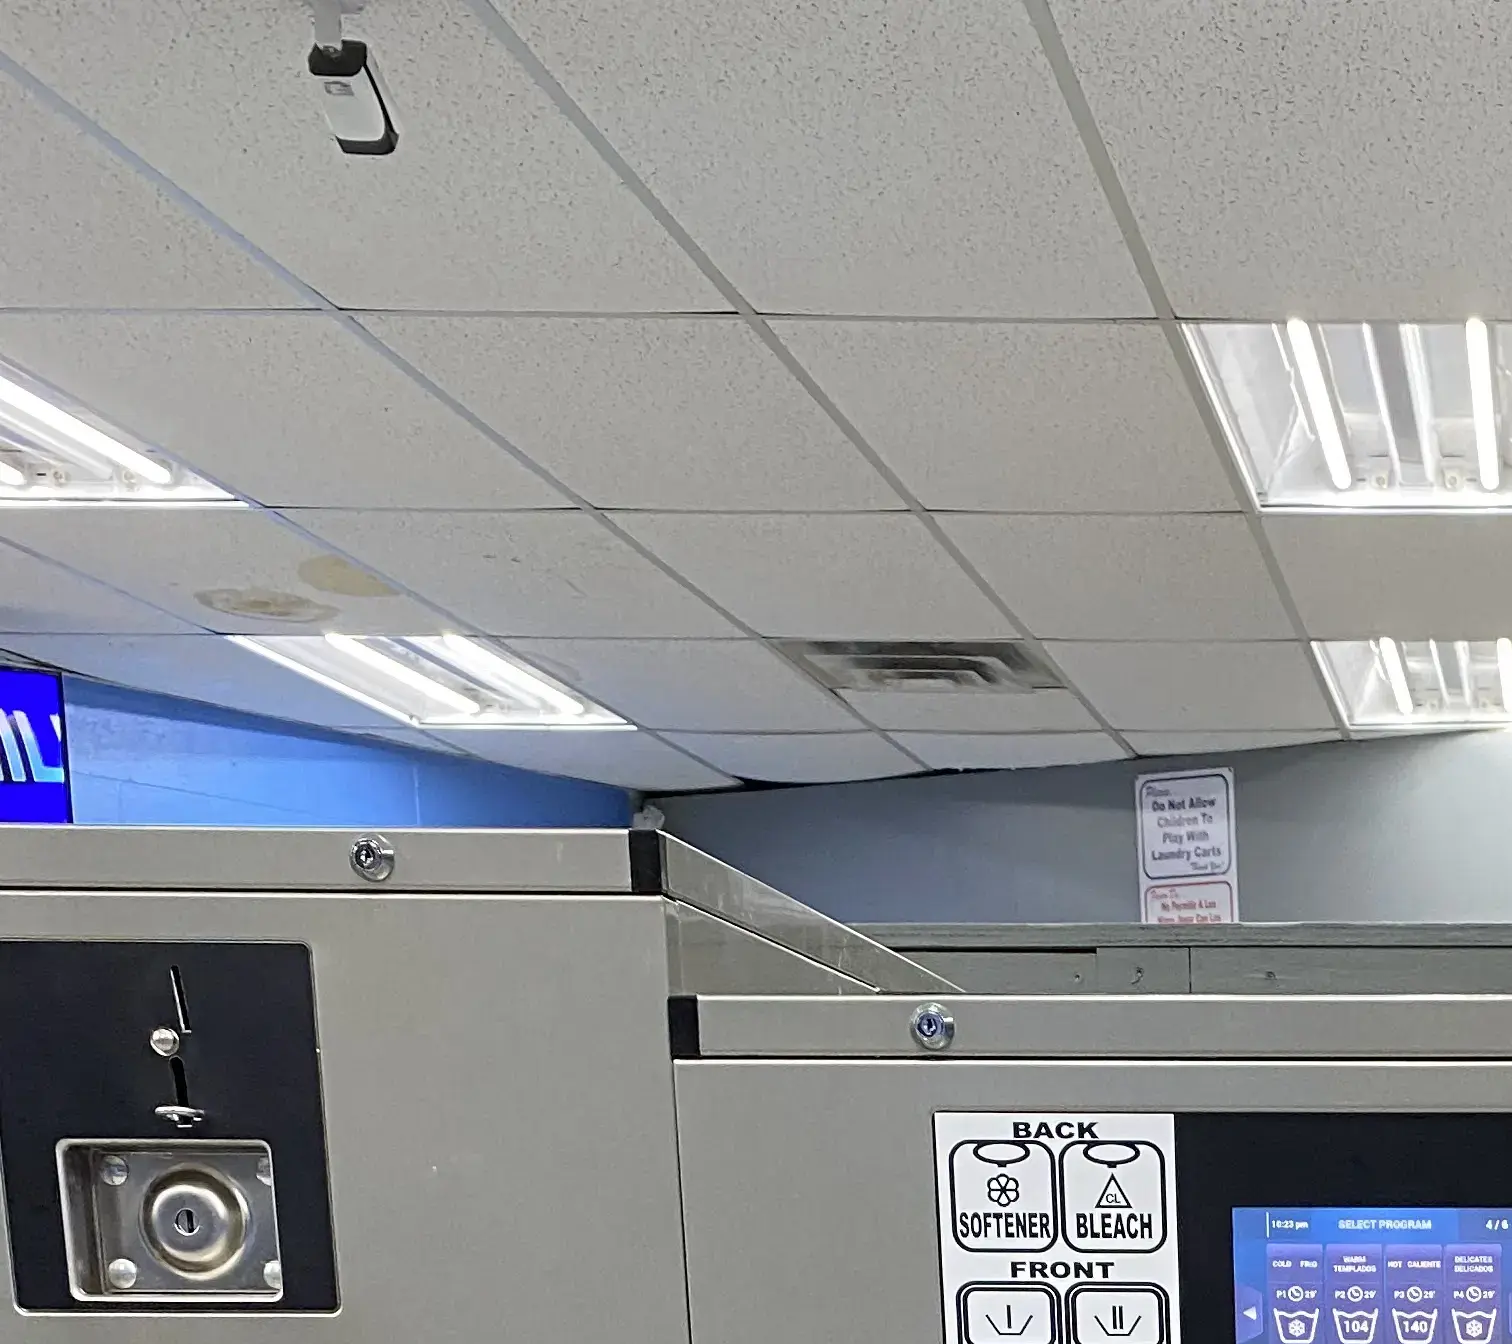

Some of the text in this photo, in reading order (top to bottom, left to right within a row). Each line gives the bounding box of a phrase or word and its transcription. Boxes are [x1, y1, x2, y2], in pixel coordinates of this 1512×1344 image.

[1152, 800, 1166, 812] Do
[1168, 799, 1186, 810] Not
[1012, 1121, 1099, 1139] BACK
[1105, 1194, 1120, 1204] CL
[959, 1212, 1051, 1238] SOFTENER
[1076, 1213, 1153, 1239] BLEACH
[1295, 1221, 1309, 1230] pm
[1338, 1219, 1432, 1230] SELECT PROGRAM
[1010, 1261, 1114, 1278] FRONT
[1276, 1290, 1287, 1299] P1
[1334, 1290, 1346, 1299] P2
[1393, 1290, 1405, 1299] P3
[1453, 1290, 1465, 1299] P4
[1344, 1319, 1369, 1334] 104
[1402, 1319, 1428, 1334] 140
